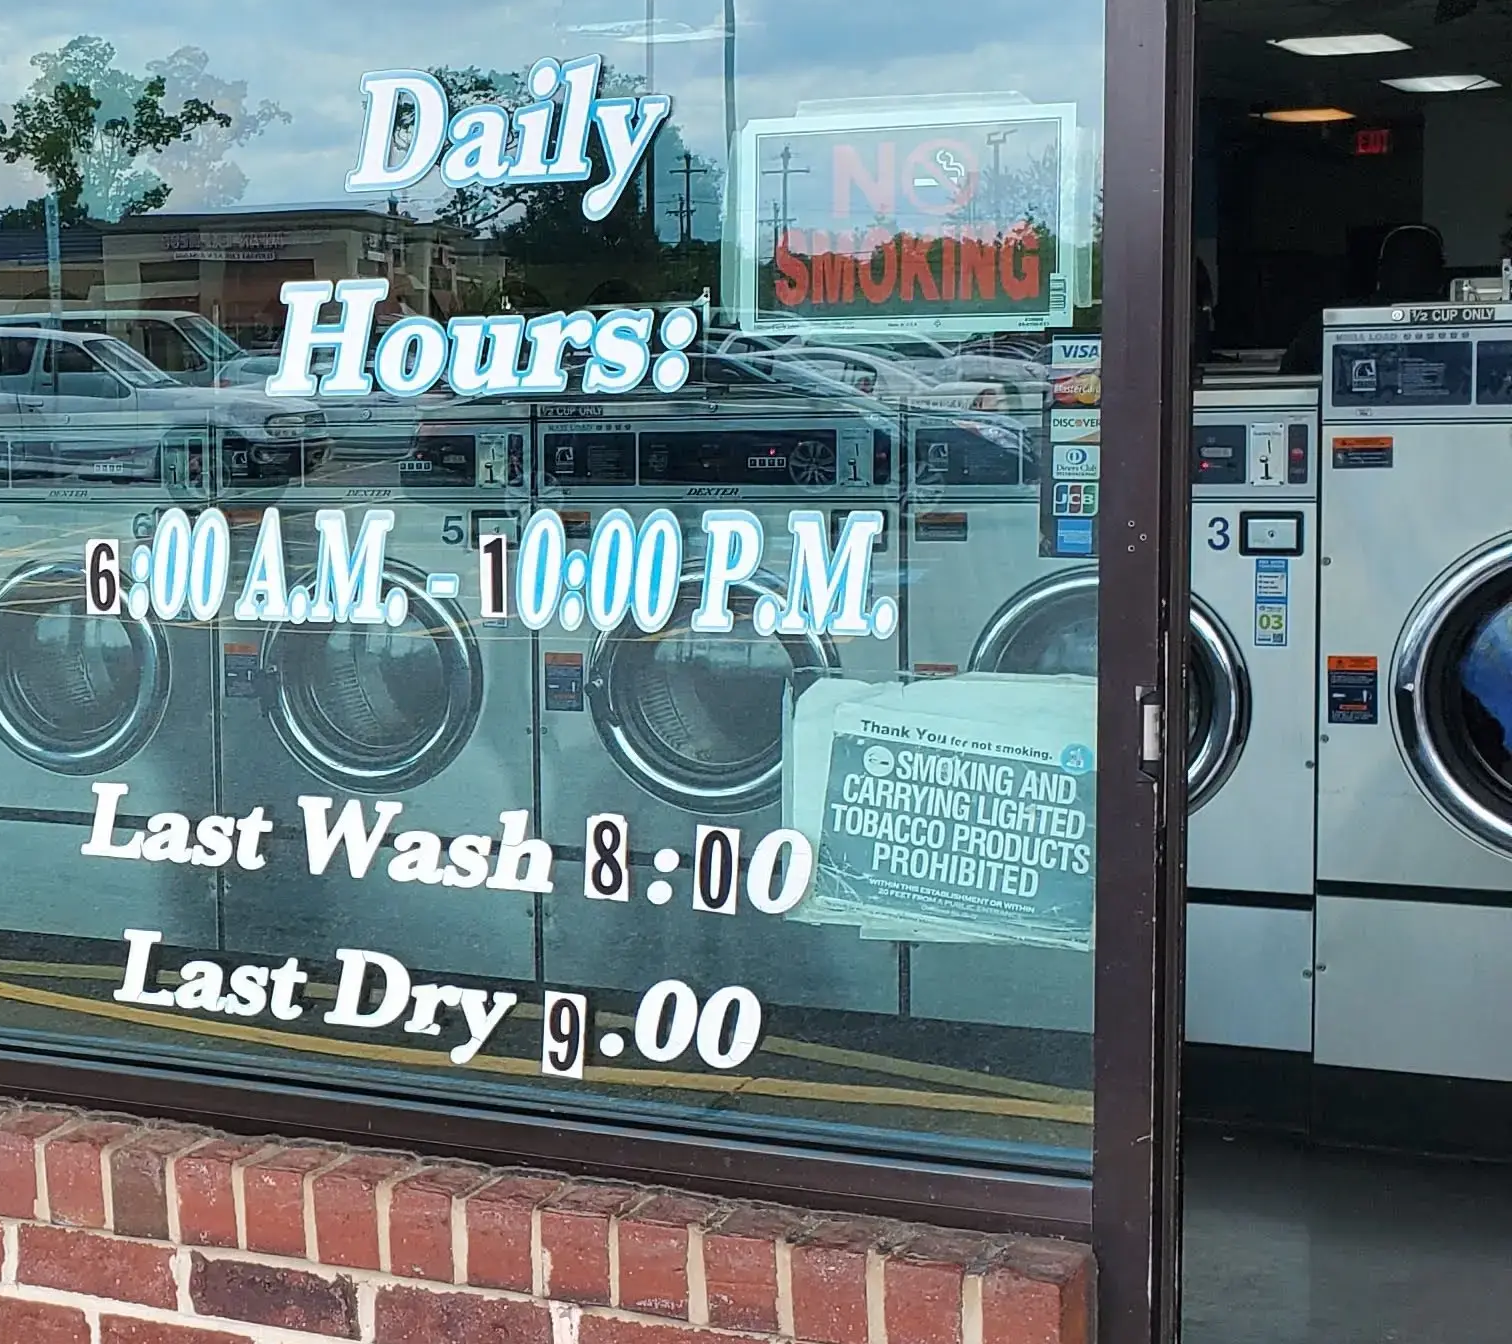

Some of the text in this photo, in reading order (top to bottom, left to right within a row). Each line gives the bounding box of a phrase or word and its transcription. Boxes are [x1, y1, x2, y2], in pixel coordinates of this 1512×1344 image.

[345, 53, 672, 222] Daily
[832, 136, 979, 218] NO
[774, 221, 1040, 307] SMOKING
[1431, 309, 1458, 321] CUP
[1462, 308, 1495, 320] ONLY
[265, 278, 698, 394] Hours:
[1061, 344, 1099, 358] VISA
[556, 406, 576, 416] CUP
[579, 406, 604, 416] ONLY
[48, 489, 88, 498] DEXTER
[346, 489, 392, 497] DEXTER
[687, 487, 740, 496] DEXTER
[1056, 493, 1094, 505] JCB
[441, 515, 464, 545] 5
[1208, 517, 1230, 551] 3
[86, 507, 230, 622] 6:00
[234, 507, 408, 627] A.M.
[481, 508, 682, 634] 10:00
[690, 508, 900, 639] P.M.
[1259, 614, 1283, 630] 03
[861, 719, 1053, 761] Thank You for not smoking.
[896, 750, 1077, 805] SMOKING AND
[843, 773, 1085, 840] CARRYING LIGHTED
[80, 782, 813, 915] Last Wash 8:00
[831, 803, 1090, 875] TOBACCO PRODUCTS
[872, 842, 1039, 898] PROHIBITED
[869, 878, 1035, 914] WITHIN THIS ESTABLISHMENT OR WITHIN
[890, 889, 911, 899] FEET
[912, 892, 937, 903] FROM
[113, 929, 307, 1021] Last
[324, 948, 516, 1064] Dry
